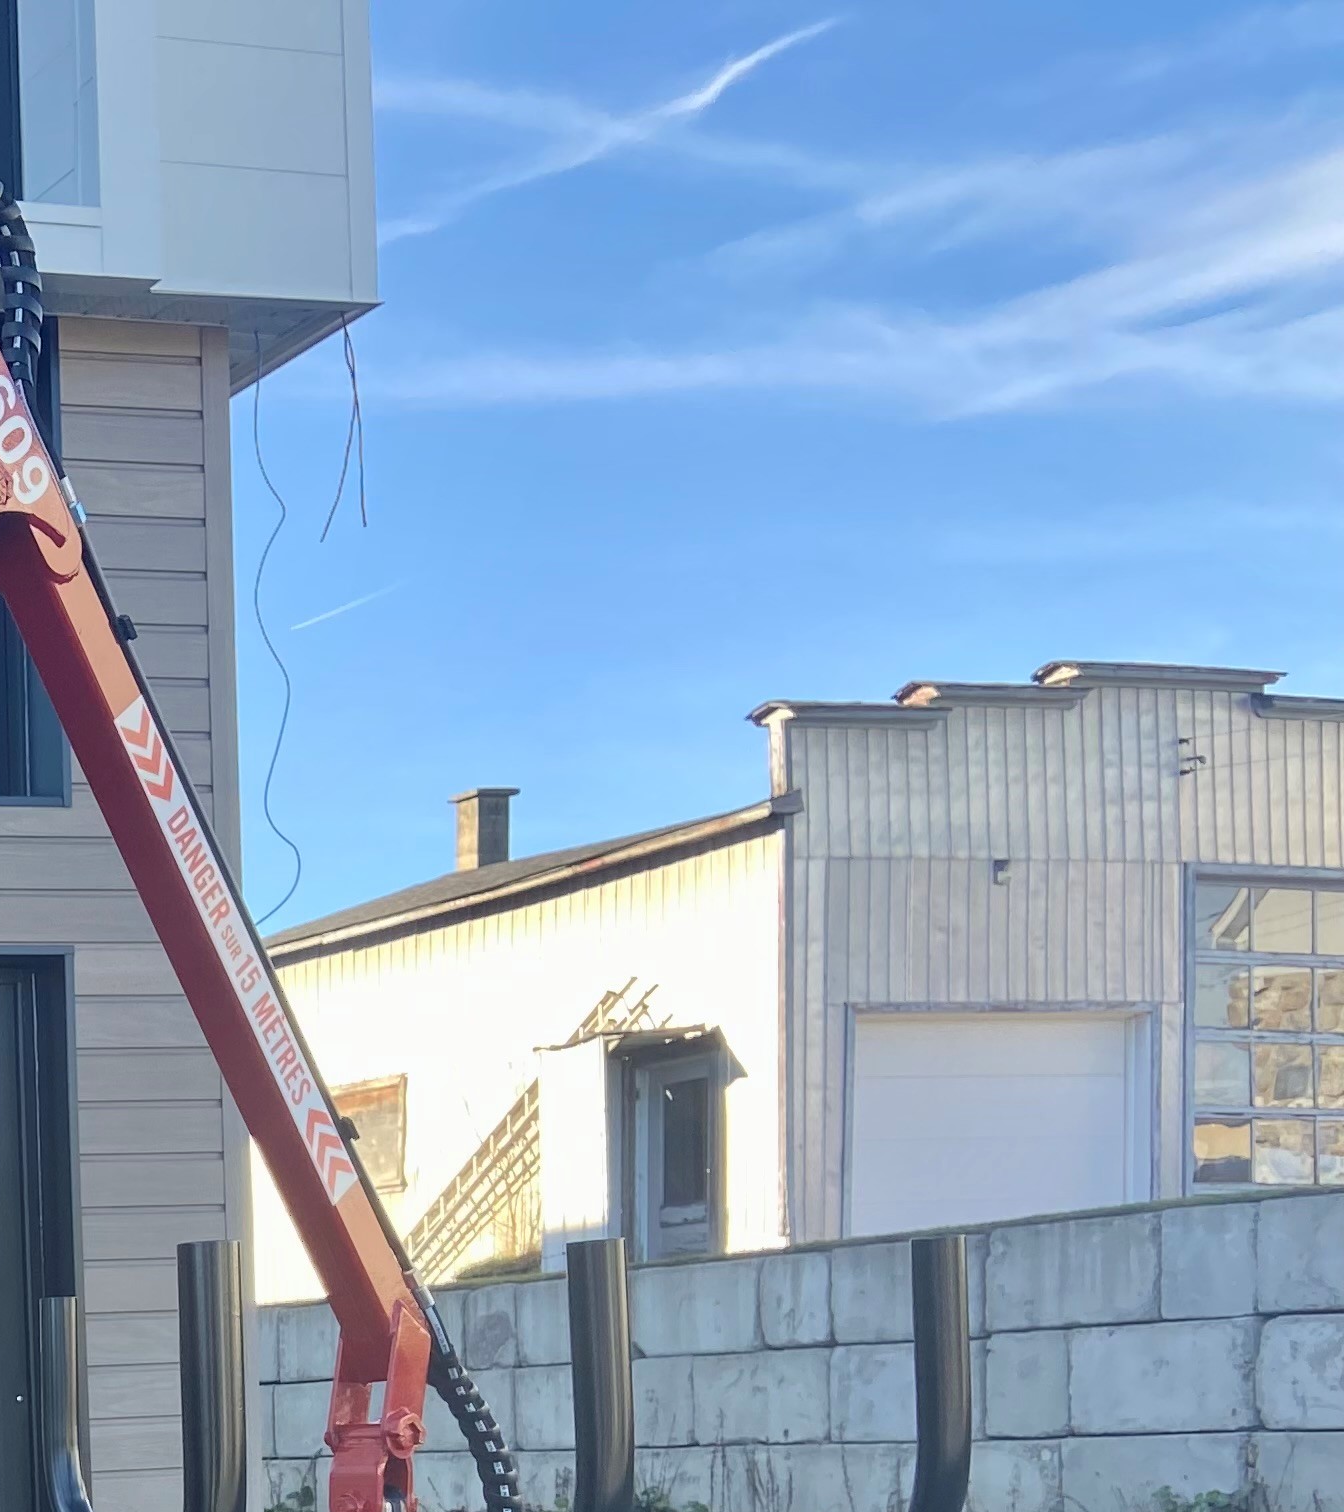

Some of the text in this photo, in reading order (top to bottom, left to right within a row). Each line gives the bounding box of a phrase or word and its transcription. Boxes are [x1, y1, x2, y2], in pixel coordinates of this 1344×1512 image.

[166, 804, 312, 1107] DANGER SUR 15 MÈTRES
